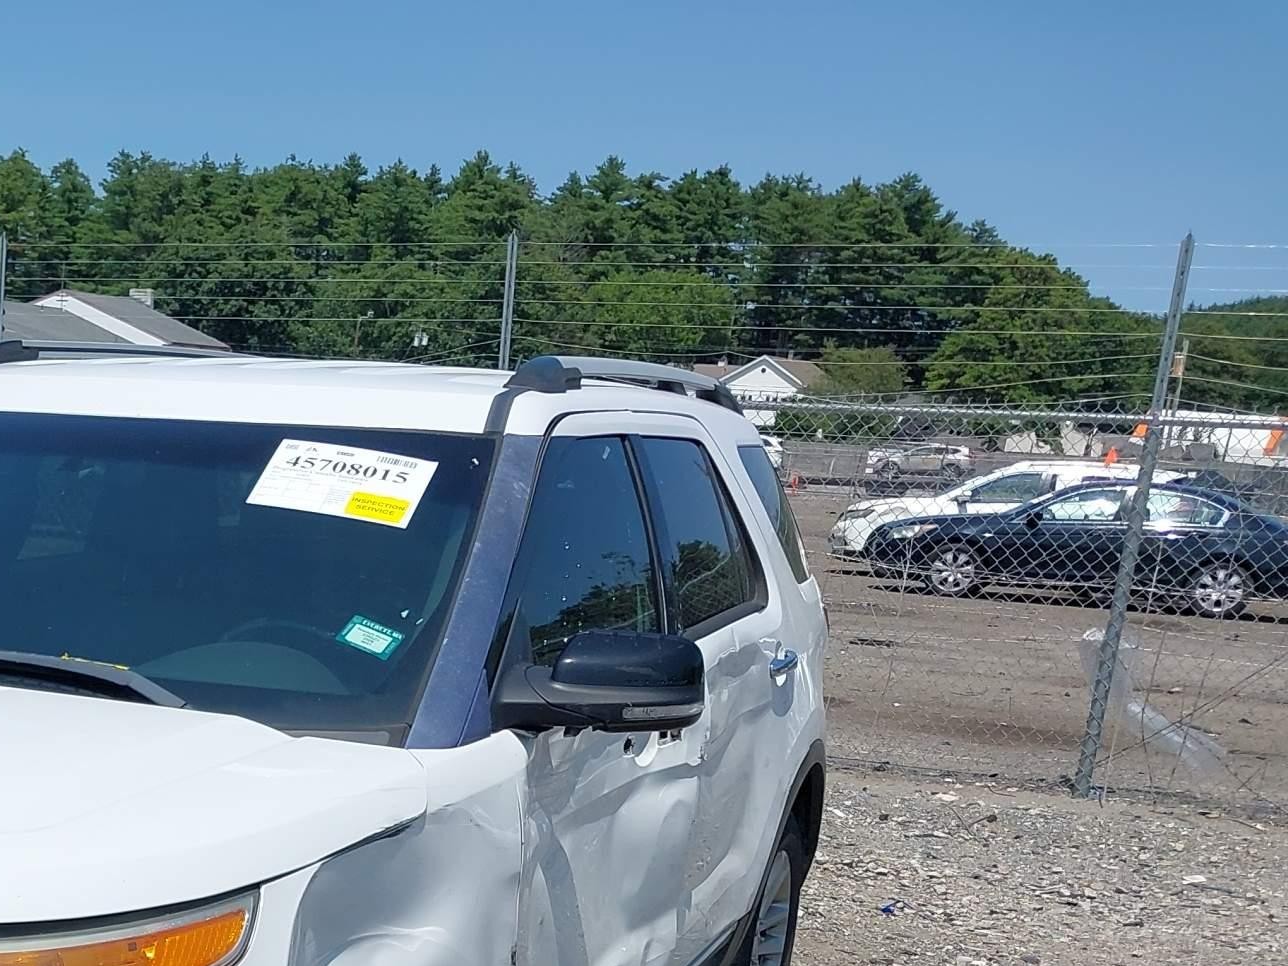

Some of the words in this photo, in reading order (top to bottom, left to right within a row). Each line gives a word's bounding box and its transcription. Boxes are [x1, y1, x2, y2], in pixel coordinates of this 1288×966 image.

[285, 454, 410, 484] 45708015
[352, 496, 406, 511] INSPECTION
[355, 504, 395, 516] SERVICE
